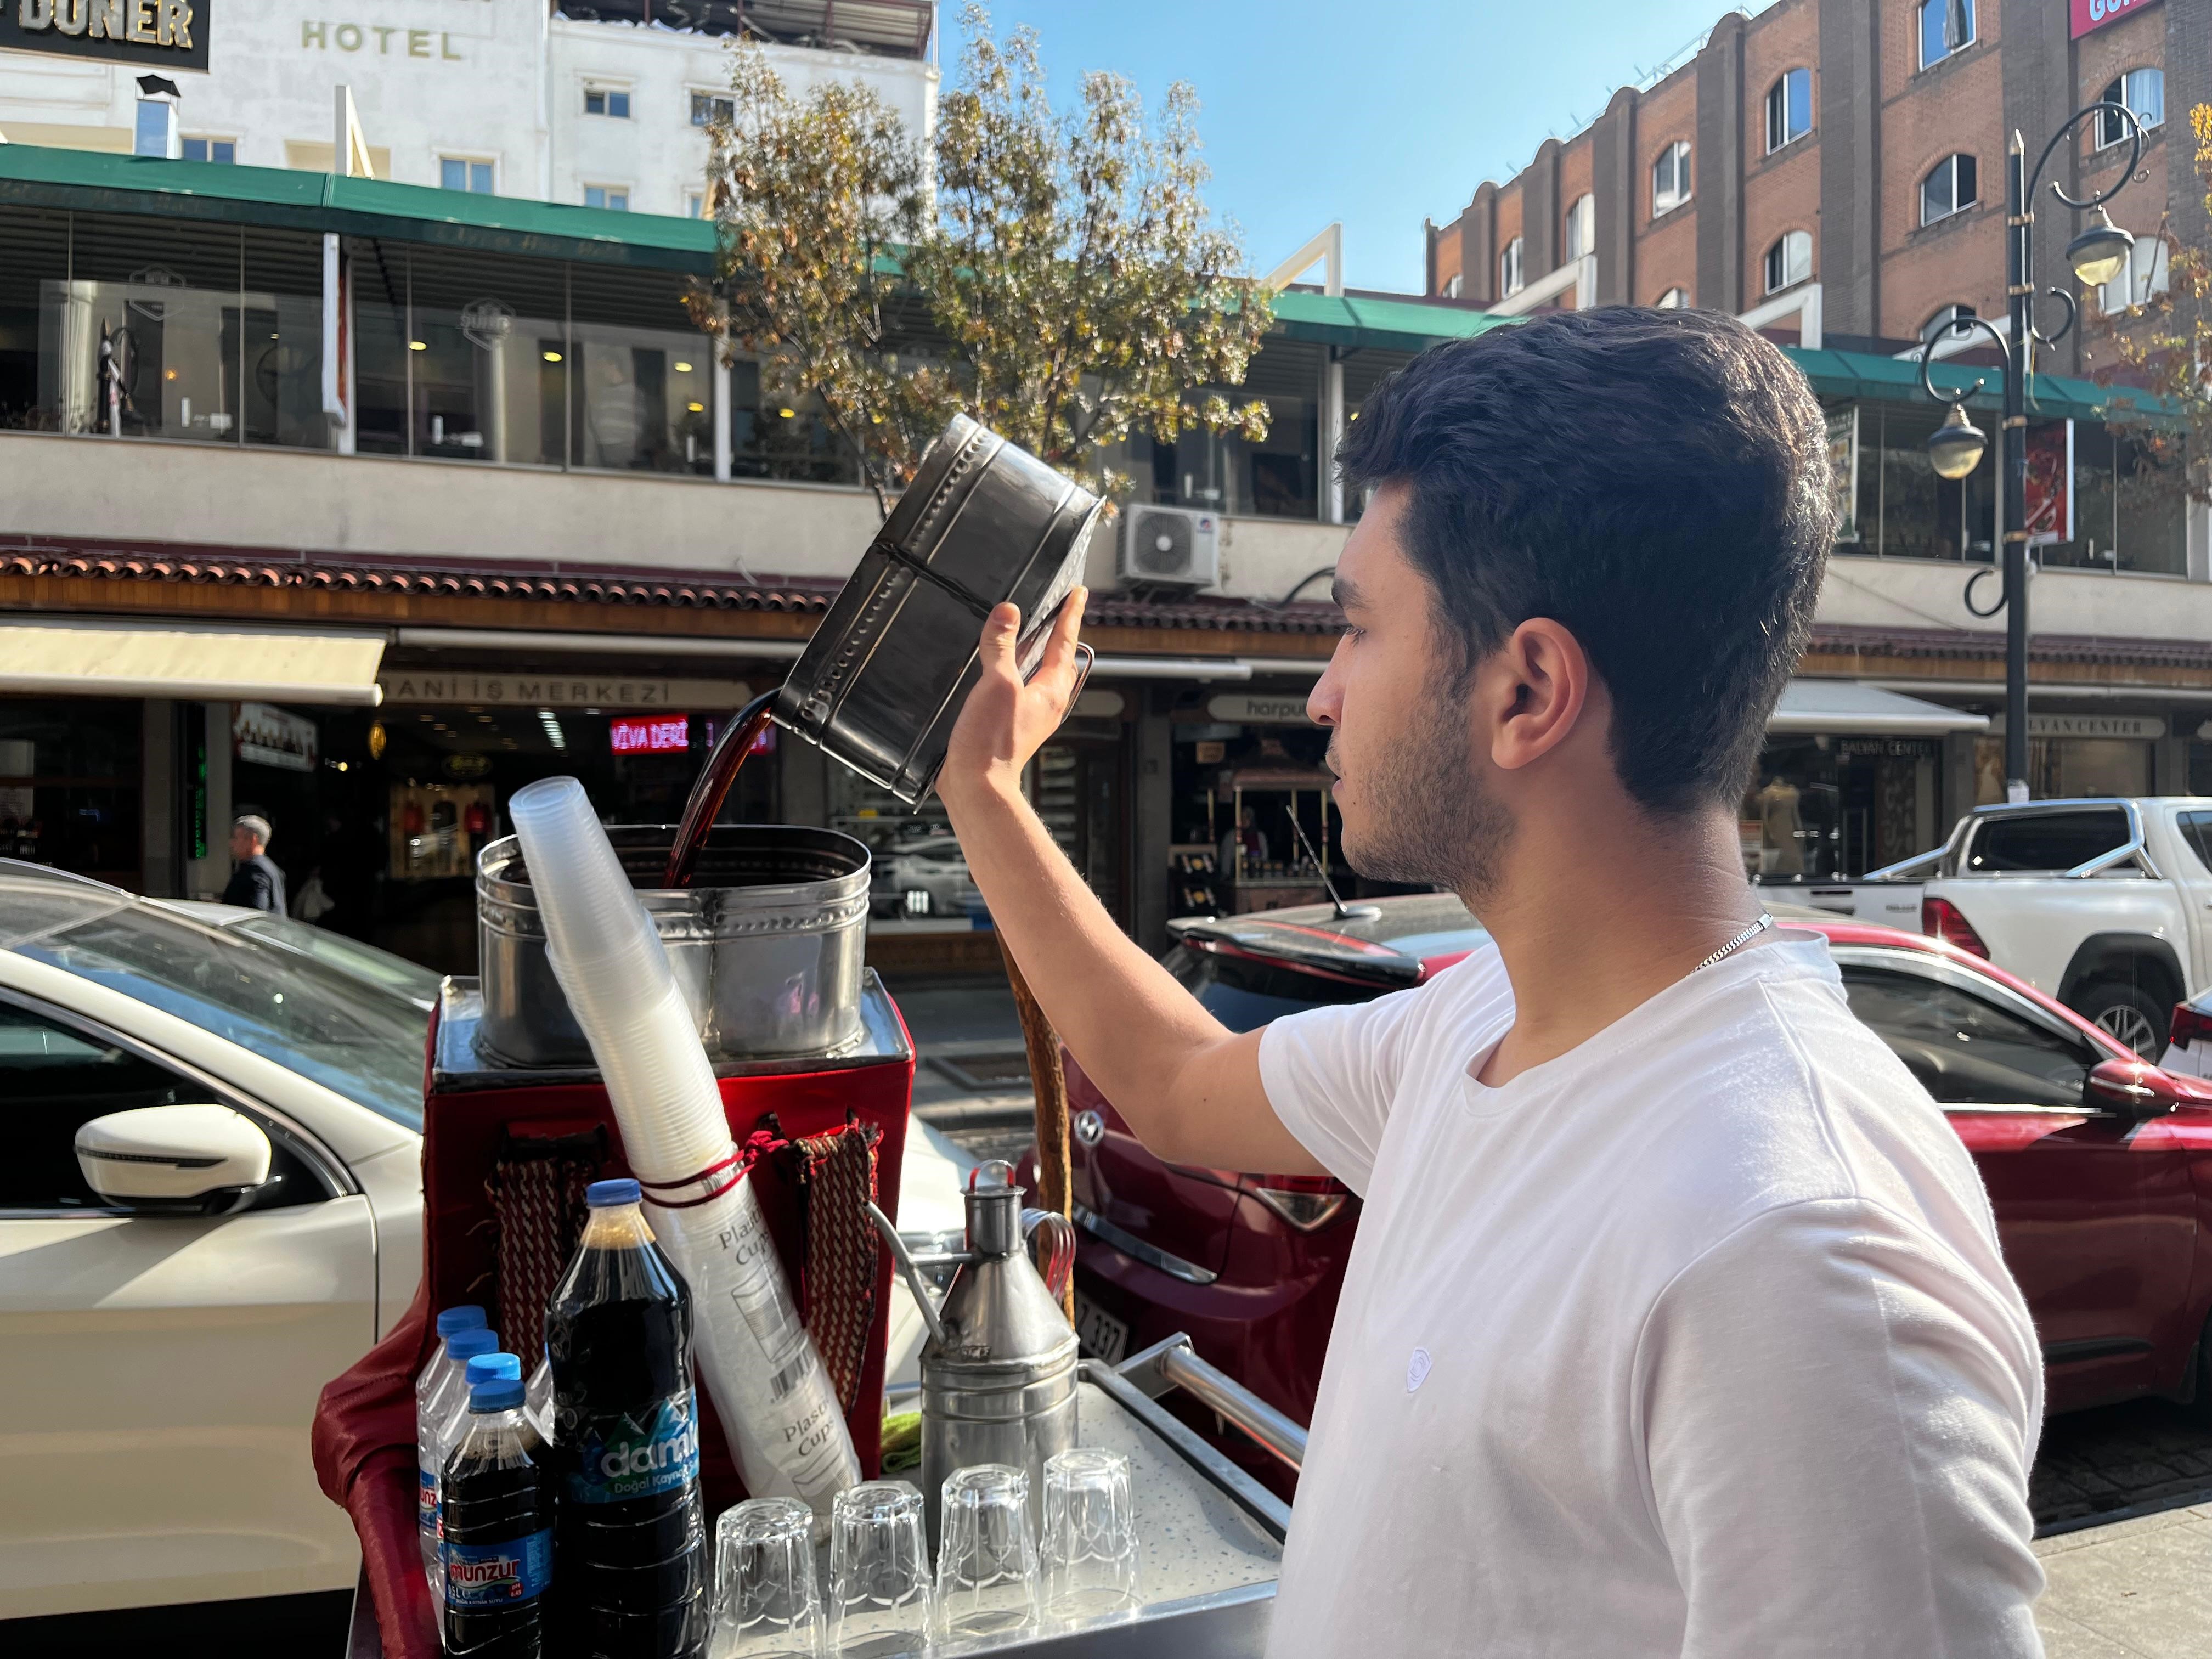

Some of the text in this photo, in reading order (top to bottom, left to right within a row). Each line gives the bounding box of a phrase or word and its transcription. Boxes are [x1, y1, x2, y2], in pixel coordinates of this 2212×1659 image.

[301, 20, 461, 61] HOTEL
[2028, 717, 2072, 732] LYAN
[1089, 1314, 1120, 1361] 337
[614, 1477, 650, 1494] Doğal
[449, 1559, 521, 1582] munzur
